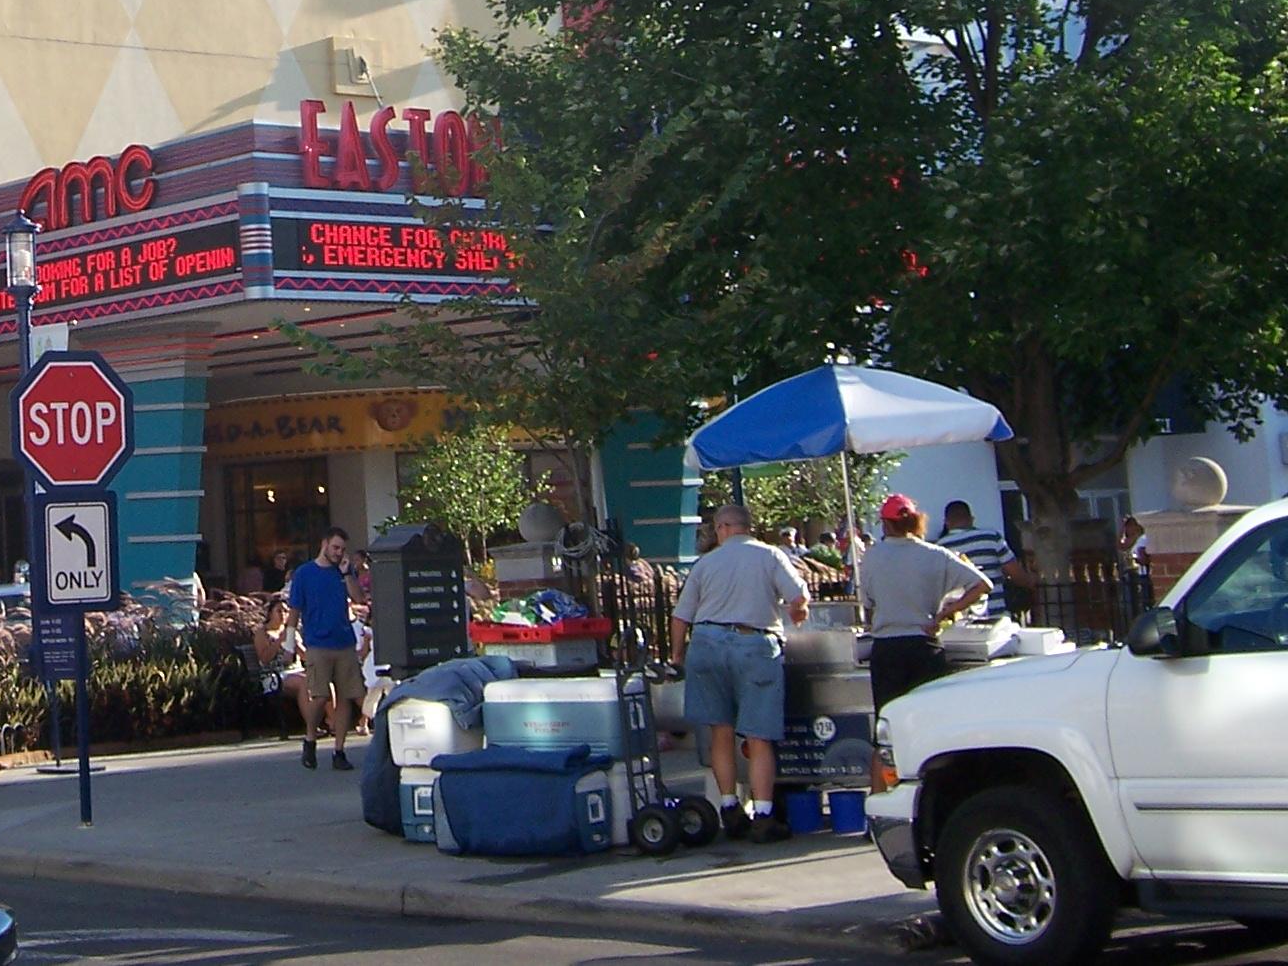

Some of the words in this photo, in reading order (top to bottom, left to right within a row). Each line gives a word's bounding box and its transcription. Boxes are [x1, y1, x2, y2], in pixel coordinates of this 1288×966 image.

[310, 223, 392, 246] CHANGE
[402, 228, 442, 249] FOR
[35, 257, 82, 283] OOKING
[87, 252, 114, 274] FOR
[120, 247, 132, 265] A
[138, 237, 177, 263] JOB?
[324, 245, 446, 270] EMERGENCY
[61, 276, 89, 298] FOR
[94, 275, 105, 292] A
[111, 265, 147, 289] LIST
[149, 260, 169, 281] OF
[29, 401, 116, 446] STOP
[55, 570, 104, 591] ONLY
